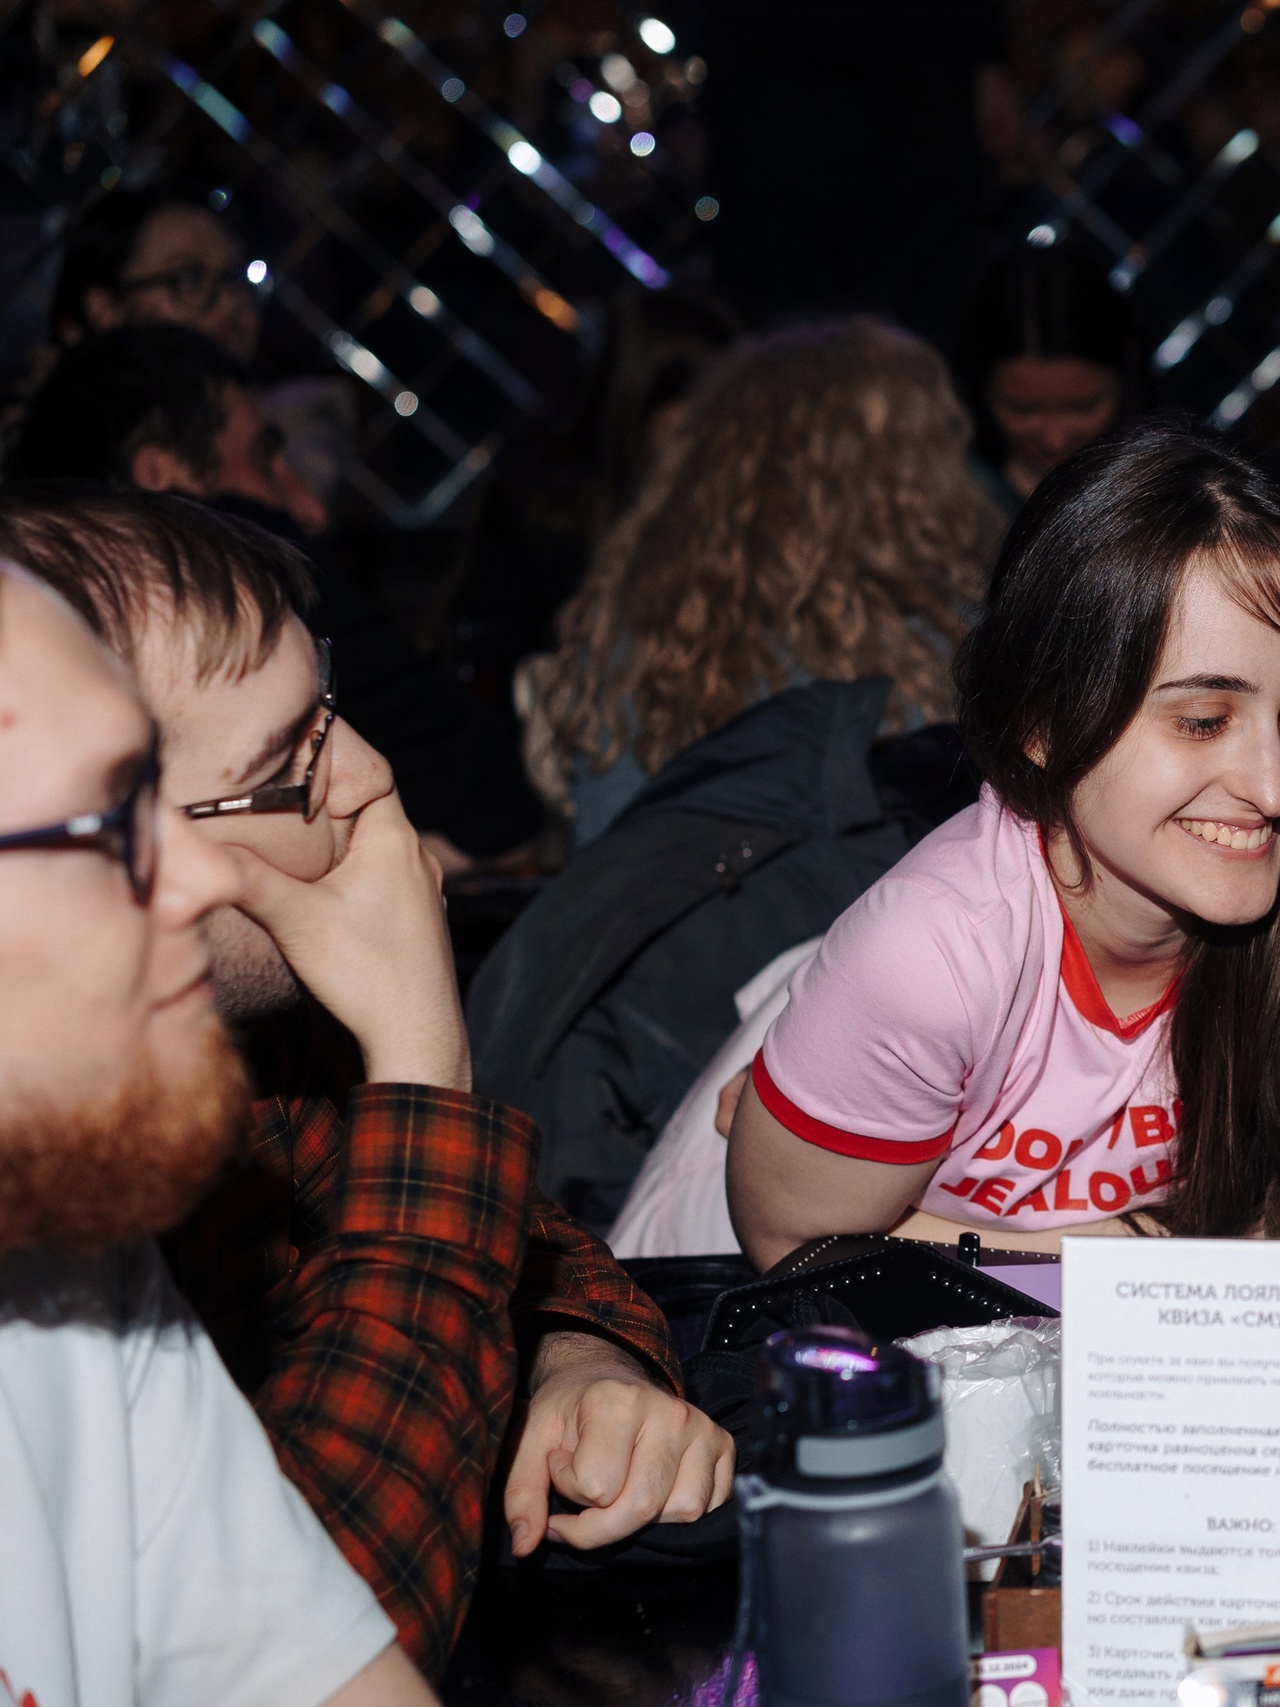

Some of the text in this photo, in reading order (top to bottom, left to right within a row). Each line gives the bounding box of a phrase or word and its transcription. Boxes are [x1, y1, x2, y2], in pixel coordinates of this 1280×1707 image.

[1129, 1096, 1184, 1149] B
[939, 1160, 1173, 1217] JEALOU
[1115, 1281, 1217, 1301] СИСТЕМА
[1158, 1307, 1224, 1326] КВИЗА
[1087, 1418, 1177, 1434] Полностью
[1181, 1424, 1280, 1438] заполненная
[1087, 1441, 1159, 1455] карточка
[1162, 1443, 1257, 1457] равноценна
[1087, 1456, 1178, 1472] бесплатное
[1181, 1462, 1271, 1476] посещение
[1206, 1516, 1276, 1533] ВАЖНО:
[1088, 1539, 1100, 1554] 1)
[1102, 1540, 1175, 1555] Наклейки
[1179, 1544, 1253, 1557] выдаются
[1087, 1561, 1171, 1575] посещение
[1087, 1590, 1100, 1605] 2)
[1104, 1591, 1141, 1607] Срок
[1145, 1593, 1216, 1608] действия
[1087, 1613, 1107, 1624] но
[1197, 1615, 1223, 1626] как
[1087, 1643, 1177, 1661] 3) Карточки,
[1087, 1666, 1171, 1680] передавать
[1087, 1686, 1115, 1698] или
[1118, 1687, 1156, 1701] даже
